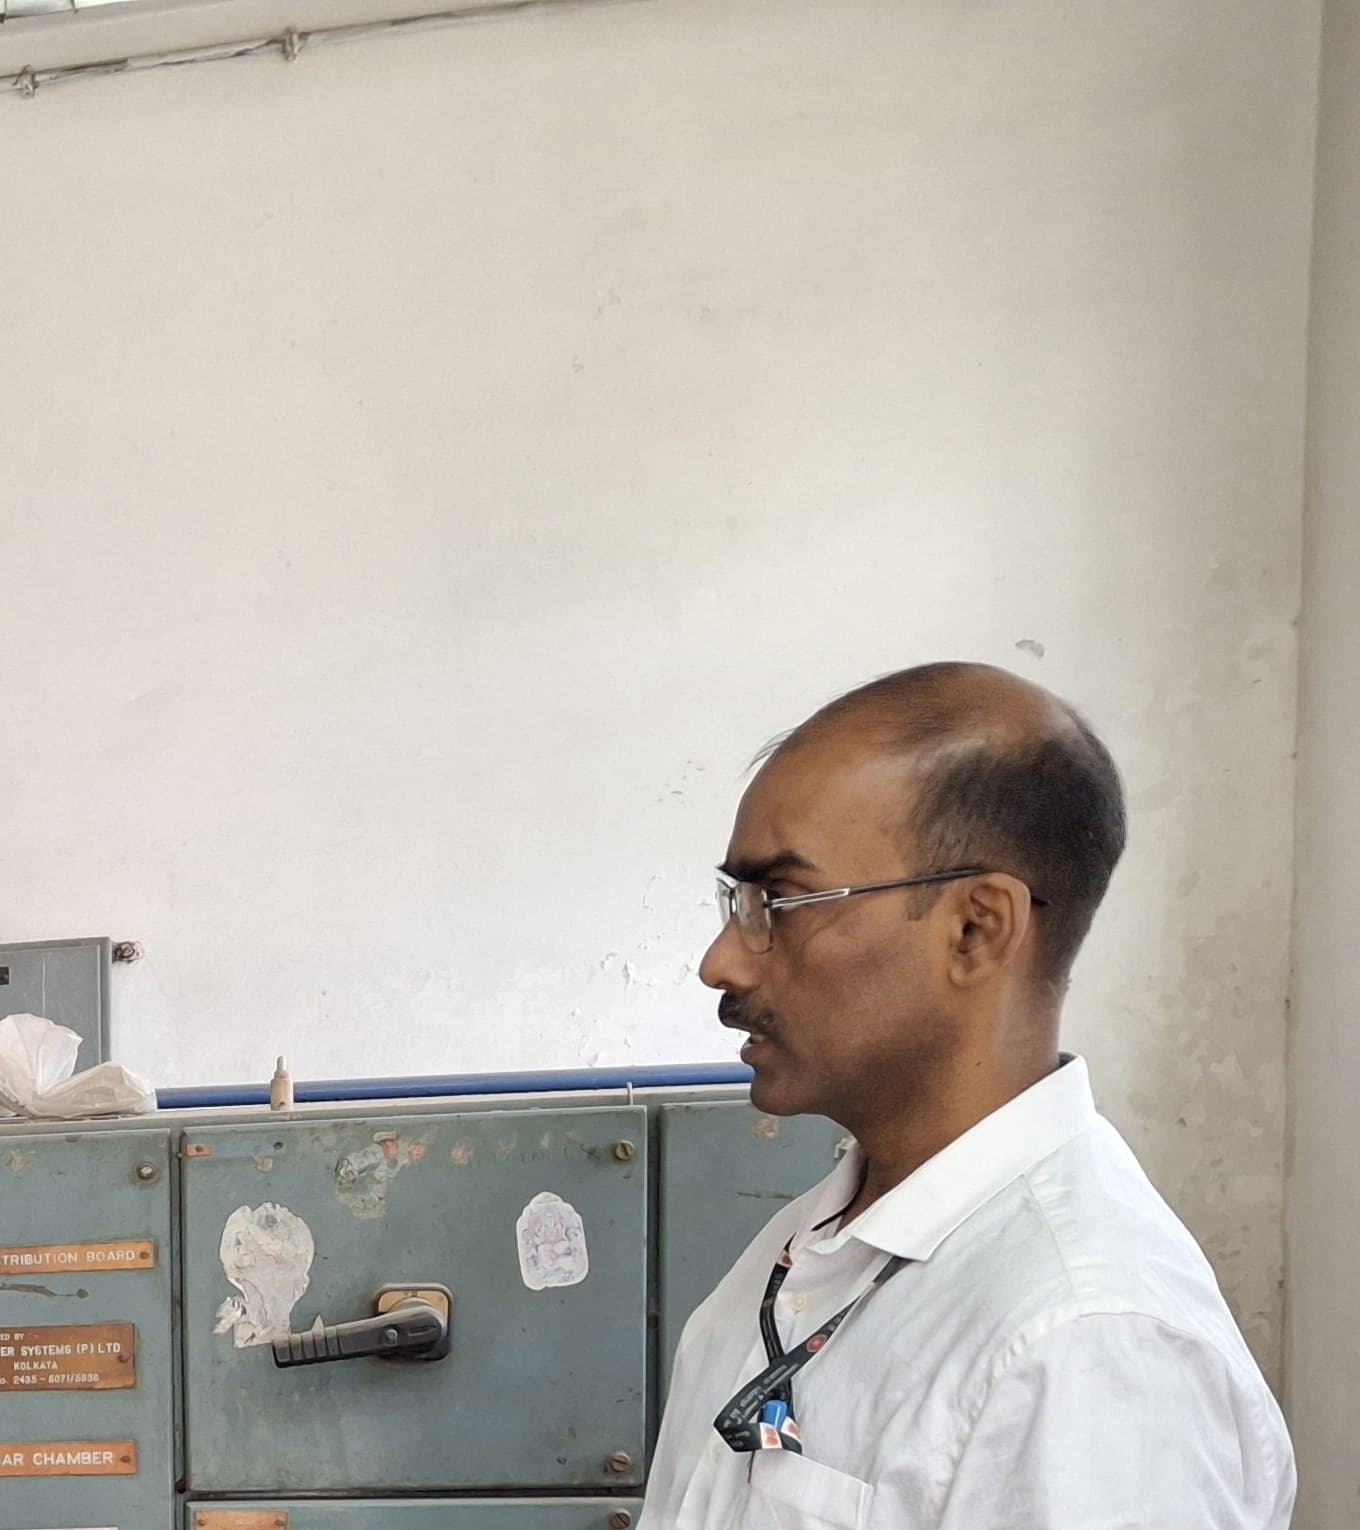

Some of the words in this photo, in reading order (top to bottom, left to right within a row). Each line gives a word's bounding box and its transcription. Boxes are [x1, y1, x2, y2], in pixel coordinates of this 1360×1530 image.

[86, 1249, 136, 1263] BOARD
[14, 1333, 25, 1342] BY
[20, 1344, 72, 1356] SYSTEMS
[76, 1343, 95, 1355] (P)
[97, 1342, 121, 1354] LTD
[13, 1361, 58, 1371] KOLKATA
[32, 1451, 113, 1466] CHAMBER
